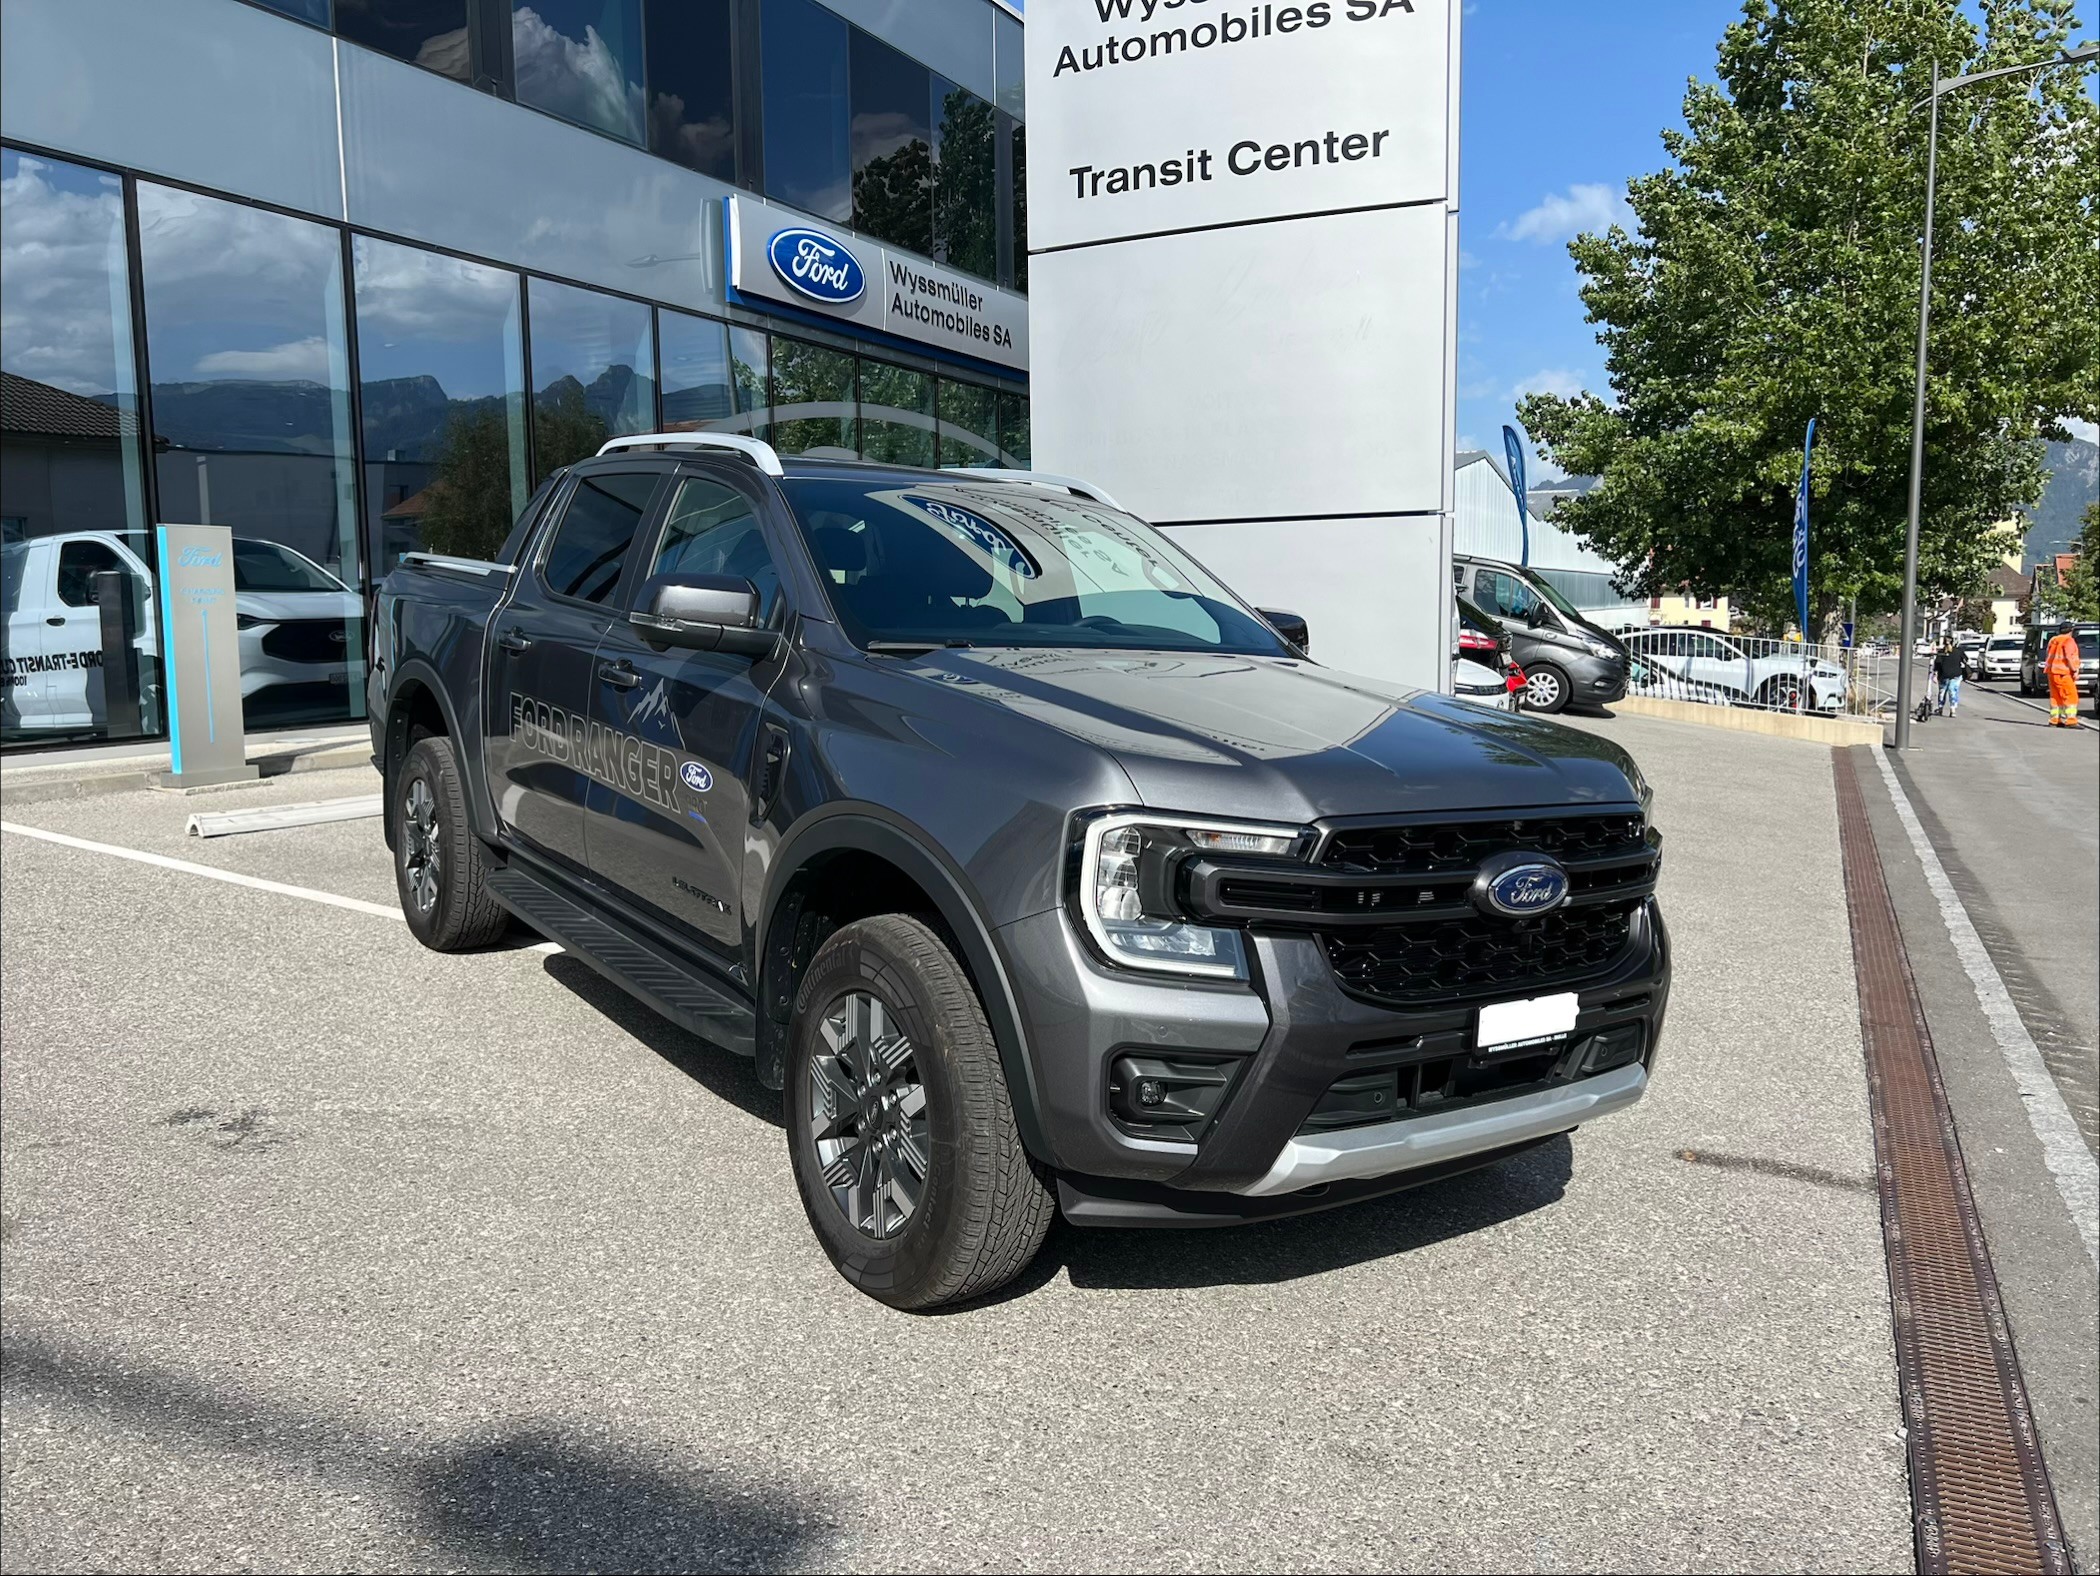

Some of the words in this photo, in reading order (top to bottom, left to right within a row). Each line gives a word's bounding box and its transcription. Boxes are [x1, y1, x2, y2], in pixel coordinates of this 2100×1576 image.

[1053, 2, 1331, 77] Automobiles
[1069, 149, 1212, 198] Transit
[1228, 129, 1389, 176] Center
[791, 238, 849, 291] Ford
[889, 260, 983, 312] Wyssmüller
[891, 292, 990, 341] Automobiles
[993, 324, 1012, 349] SA
[178, 545, 223, 568] Ford
[509, 691, 569, 762] FORD
[570, 715, 681, 814] RANGER
[686, 764, 707, 789] Ford
[1511, 876, 1553, 904] Ford
